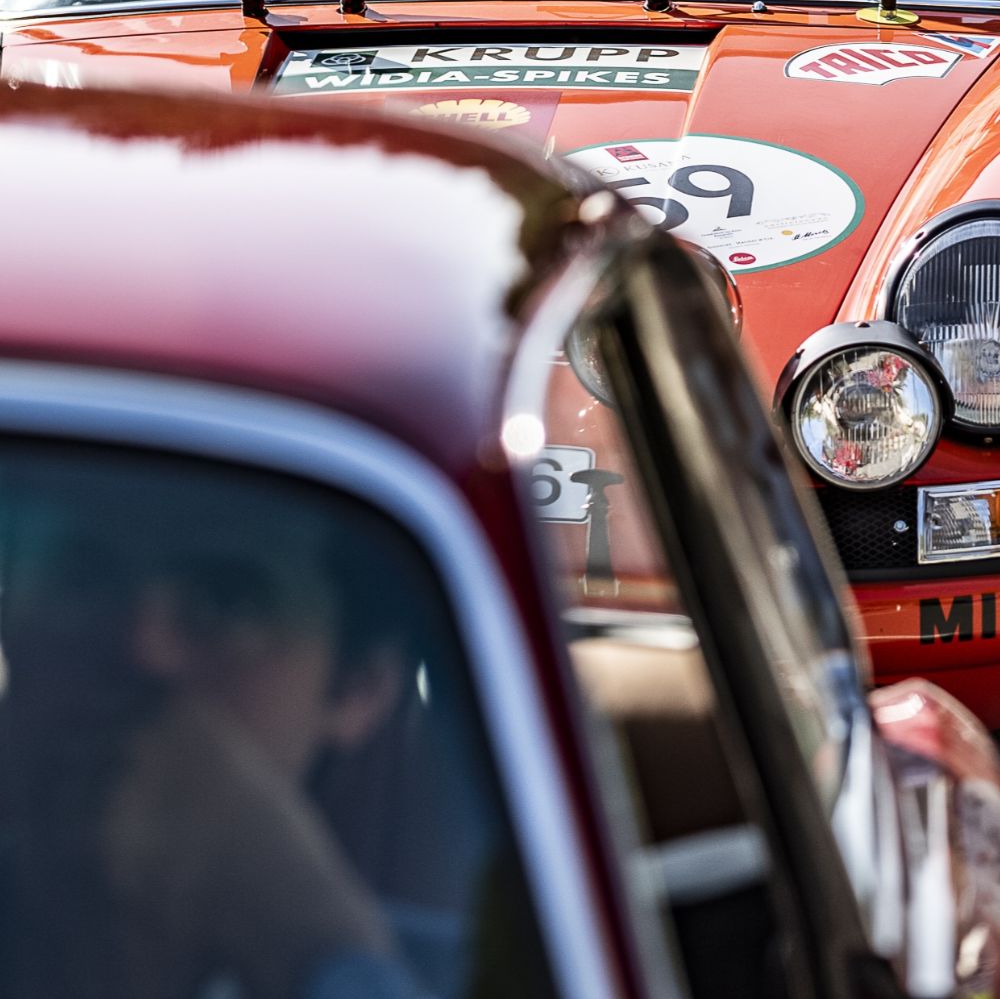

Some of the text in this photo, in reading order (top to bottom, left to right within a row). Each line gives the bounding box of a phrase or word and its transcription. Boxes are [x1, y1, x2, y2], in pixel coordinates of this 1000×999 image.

[410, 46, 681, 64] KRUPP
[799, 48, 949, 79] TRICO
[305, 69, 671, 89] WIDIA-SPIKES
[433, 111, 513, 124] HELL
[604, 163, 755, 232] 59
